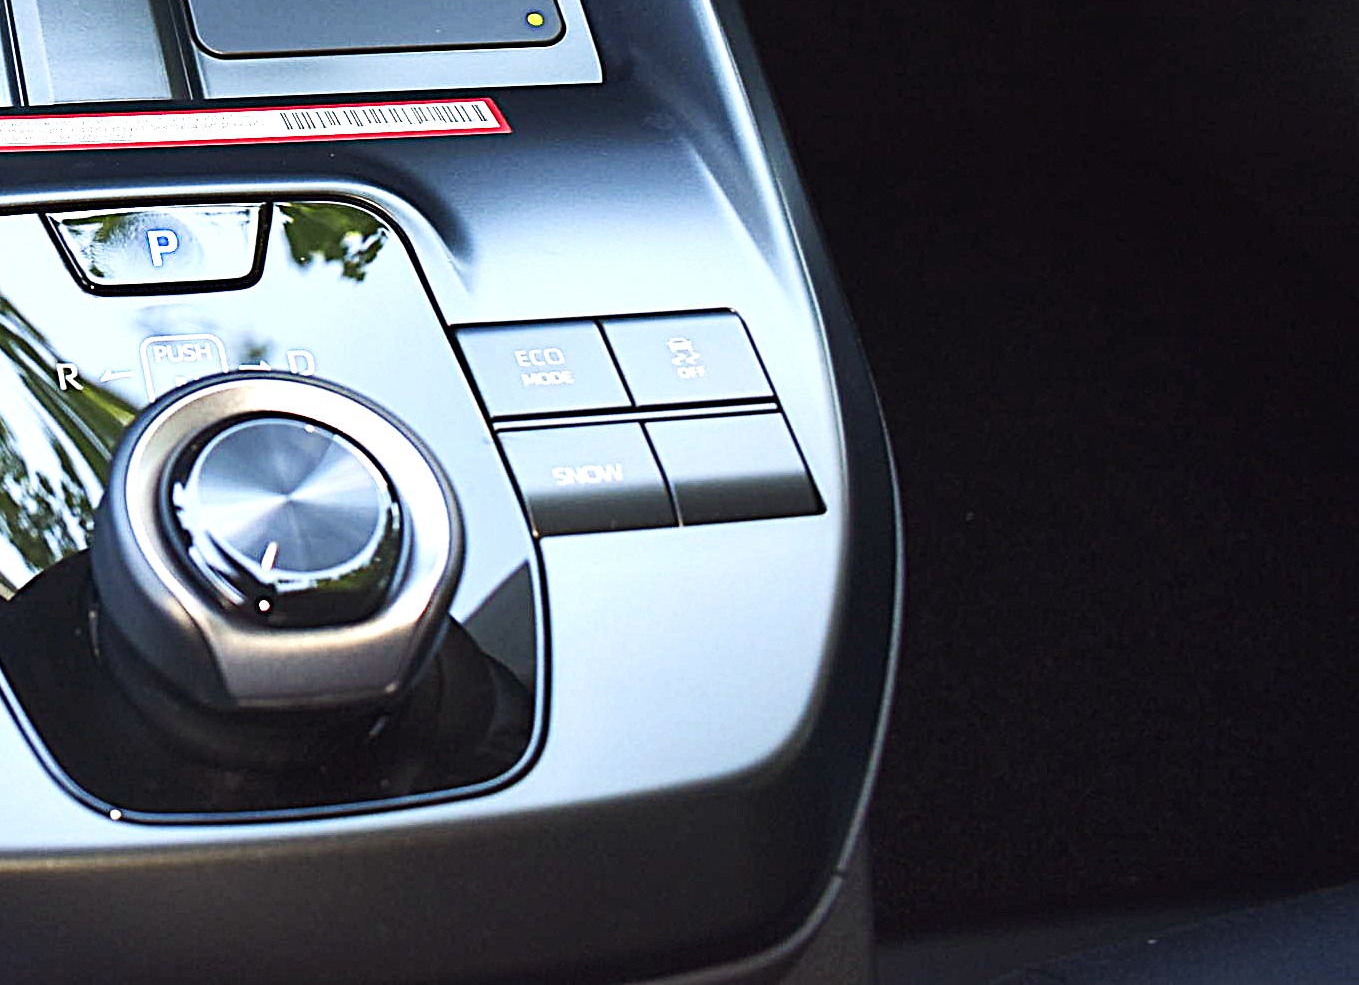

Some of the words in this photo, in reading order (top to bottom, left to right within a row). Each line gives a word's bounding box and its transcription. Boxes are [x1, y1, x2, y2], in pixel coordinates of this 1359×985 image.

[146, 228, 180, 267] P
[152, 342, 213, 363] PUSH
[286, 349, 317, 377] D
[514, 347, 565, 367] ECO
[55, 362, 84, 392] R
[520, 370, 575, 387] MODE
[676, 365, 706, 379] OFF
[551, 463, 624, 486] SNOW
